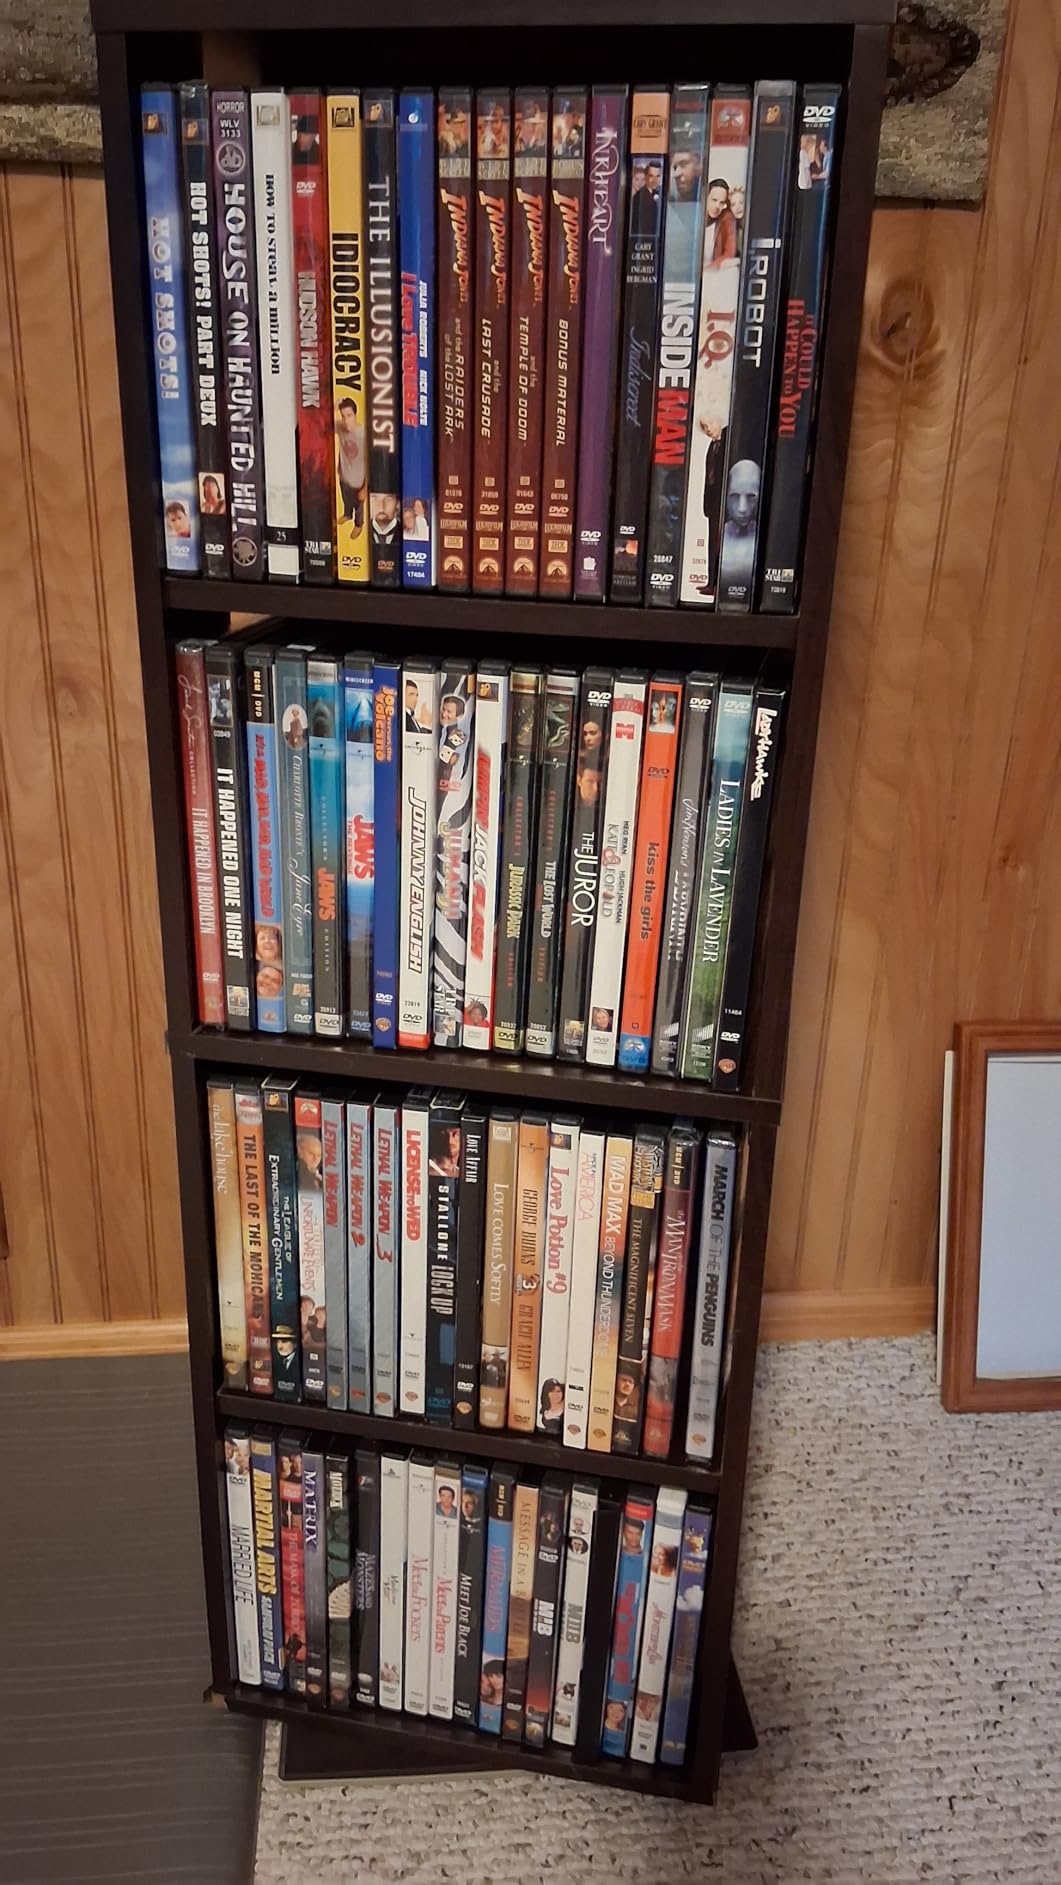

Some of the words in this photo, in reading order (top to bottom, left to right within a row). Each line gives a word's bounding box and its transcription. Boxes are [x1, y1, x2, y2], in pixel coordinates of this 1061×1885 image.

[217, 101, 245, 113] HORROR
[220, 119, 240, 128] WLV
[803, 106, 835, 116] DVD
[220, 129, 241, 138] 3133
[190, 183, 208, 225] HOT
[368, 176, 390, 242] THE
[588, 127, 621, 256] INKHEART
[152, 217, 173, 282] HOT
[223, 183, 249, 304] HOUSE
[631, 252, 654, 261] GRANT
[635, 243, 652, 251] CARY
[192, 232, 212, 307] SHOTS!
[626, 275, 658, 284] BERGMAN
[631, 266, 654, 274] INGRID
[298, 271, 319, 348] HUDSON
[332, 232, 362, 392] IDIOCRACY
[419, 280, 428, 309] JULIA
[154, 292, 180, 400] SHOTS!
[196, 314, 215, 368] PART
[226, 311, 250, 347] ON
[482, 318, 492, 358] LAST
[519, 316, 529, 371] TEMPLE
[558, 318, 569, 370] BONUS
[659, 282, 695, 388] INSIDE
[370, 257, 395, 453] ILLUSIONIST
[199, 375, 217, 426] DEUX
[300, 351, 321, 409] HAWK
[481, 361, 491, 438] CRUSADE
[519, 374, 528, 395] OF
[227, 357, 255, 473] HAUNTED
[518, 398, 528, 440] DOOM
[556, 374, 567, 446] MATERIAL
[654, 387, 689, 465] MAN
[231, 482, 258, 532] HILL
[276, 531, 287, 541] 25
[588, 691, 612, 699] DVD
[375, 692, 386, 762] volcano
[217, 768, 234, 784] IT
[192, 808, 208, 816] IT
[218, 788, 239, 871] HAPPENED
[714, 779, 741, 848] LADIES
[193, 817, 212, 869] HAPPENED
[352, 815, 375, 880] JAWS
[409, 787, 428, 885] JOHNNY
[472, 823, 488, 888] JACK
[582, 832, 595, 854] THE
[196, 873, 212, 883] IN
[437, 821, 464, 919] JUMANJI
[545, 861, 557, 880] THE
[646, 842, 659, 874] kiss
[712, 851, 725, 866] IN
[223, 876, 241, 907] ONE
[287, 857, 311, 904] Jane
[317, 867, 336, 921] JAWS
[509, 863, 526, 911] JURASSIC
[543, 880, 556, 903] LOST
[571, 848, 599, 927] JUROR
[644, 880, 655, 902] the
[197, 885, 216, 934] BROOKLYN
[293, 902, 312, 936] Eyre
[408, 883, 424, 974] ENGLISH
[506, 910, 522, 938] PARK
[540, 903, 554, 938] WORLD
[615, 892, 625, 924] JACKMAN
[640, 906, 652, 940] girls
[702, 867, 731, 963] LAVENDER
[225, 911, 244, 959] NIGHT
[244, 1135, 256, 1159] THE
[324, 1120, 337, 1168] LETHAL
[350, 1122, 364, 1170] LETHAL
[378, 1128, 392, 1175] LETHAL
[406, 1129, 421, 1195] LICENSE
[466, 1134, 481, 1154] LOVE
[245, 1163, 258, 1198] LAST
[465, 1157, 481, 1184] AFFAIR
[550, 1167, 570, 1210] Love
[608, 1156, 626, 1193] MAD
[247, 1202, 260, 1219] OF
[268, 1154, 281, 1237] EXTRAORDINARY
[325, 1172, 339, 1228] WEAPON
[351, 1175, 365, 1230] WEAPON
[378, 1180, 393, 1235] WEAPON
[493, 1183, 509, 1213] LOVE
[523, 1188, 538, 1225] GEORGE
[711, 1164, 728, 1221] MARCH
[248, 1222, 261, 1247] THE
[282, 1210, 292, 1251] LEAGUE
[406, 1205, 421, 1241] WED
[437, 1185, 449, 1260] STALLONE
[605, 1197, 623, 1234] MAX
[633, 1218, 643, 1239] THE
[709, 1223, 724, 1244] OF
[351, 1231, 366, 1248] 2
[377, 1233, 393, 1264] 3
[491, 1219, 504, 1260] COMES
[521, 1231, 537, 1266] BURNS
[548, 1215, 568, 1269] Potion
[602, 1236, 616, 1280] BEYOND
[706, 1249, 722, 1272] THE
[250, 1252, 264, 1320] MOHICANS
[271, 1237, 284, 1300] GENTLEMEN
[430, 1264, 454, 1296] LOCK
[490, 1262, 507, 1305] SOFTLY
[523, 1279, 537, 1290] 3
[546, 1273, 567, 1294] #9
[626, 1240, 640, 1311] MAGNIFICENT
[430, 1297, 453, 1315] UP
[518, 1304, 533, 1338] GRACIE
[598, 1280, 614, 1359] THUNDERDOME
[624, 1310, 635, 1343] SEVEN
[701, 1273, 719, 1347] PENGUINS
[517, 1345, 532, 1370] ALLEN
[253, 1467, 275, 1548] MARTIAL
[303, 1470, 318, 1546] MATRIX
[232, 1524, 252, 1579] MARRIED
[257, 1549, 277, 1595] ARTS
[234, 1580, 254, 1606] LIFE
[460, 1573, 472, 1604] MEET
[459, 1603, 472, 1624] JOE
[457, 1624, 471, 1658] BLACK
